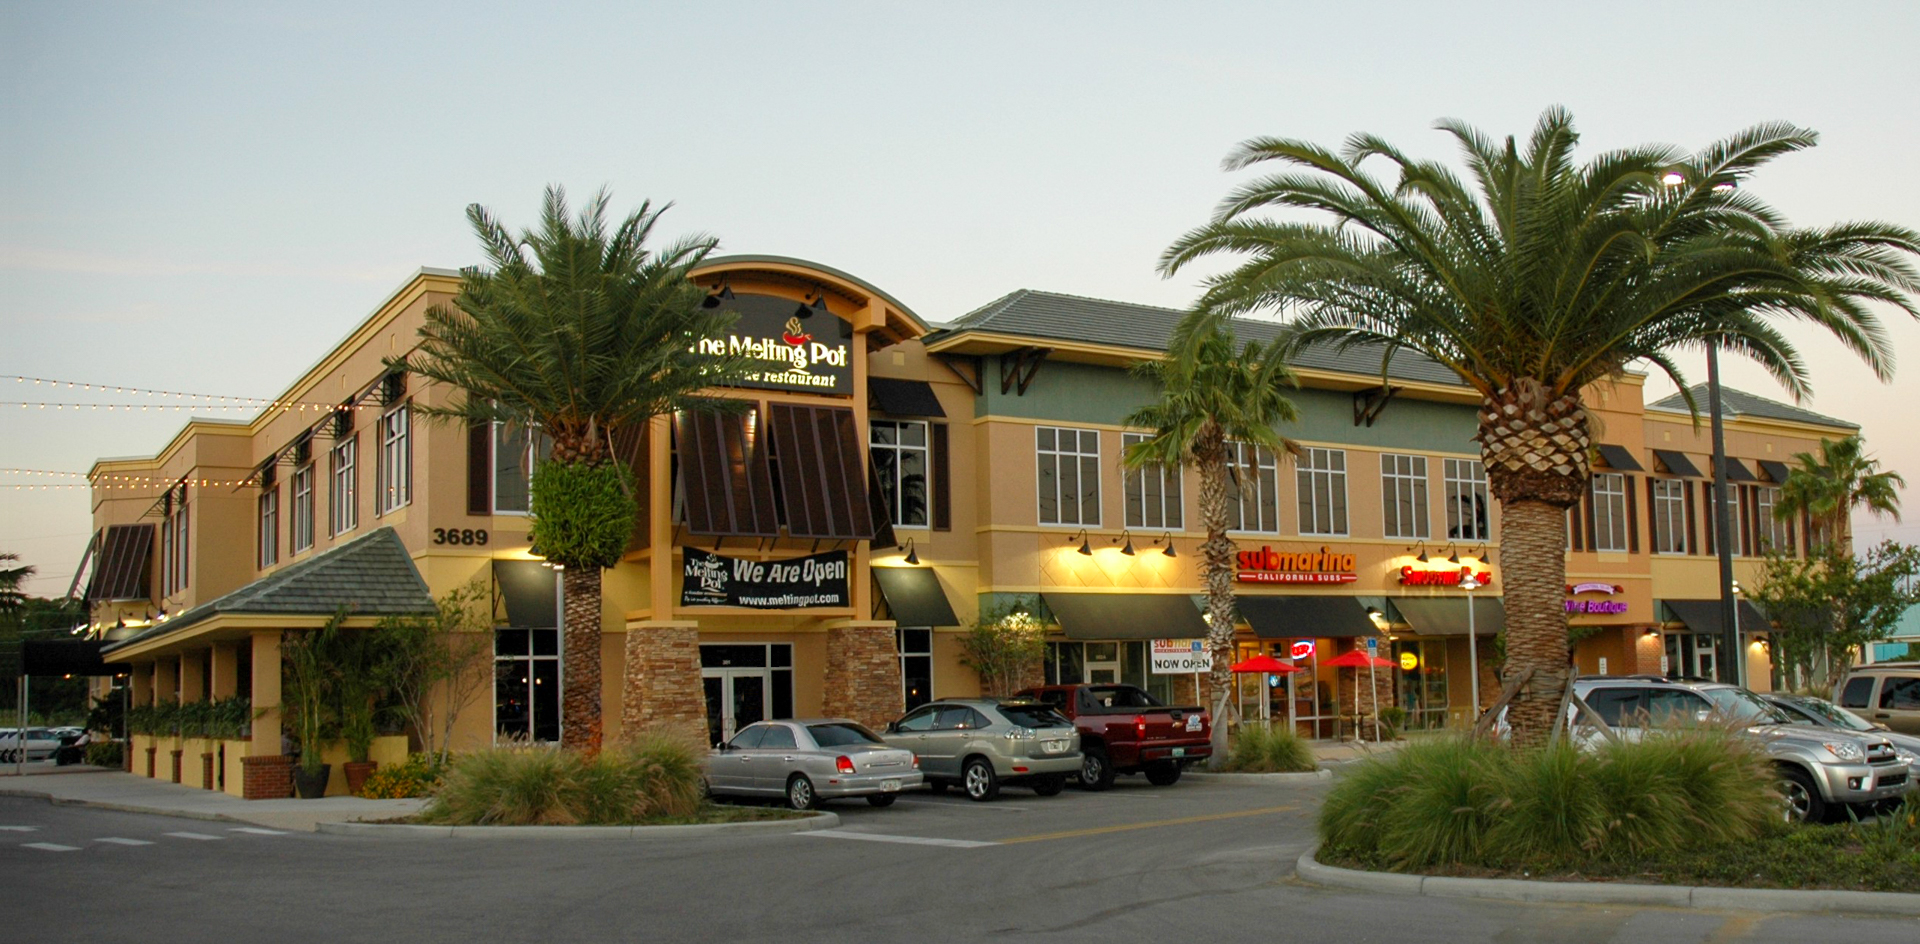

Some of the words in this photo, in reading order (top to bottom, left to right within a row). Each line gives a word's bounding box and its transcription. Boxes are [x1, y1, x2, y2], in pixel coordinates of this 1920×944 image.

[684, 331, 726, 355] he
[729, 335, 807, 368] Melting
[810, 343, 847, 366] Pot
[763, 371, 836, 387] restaurant
[433, 528, 488, 546] 3689
[690, 557, 705, 566] The
[1236, 545, 1357, 571] submarina
[685, 564, 728, 582] Melting
[733, 558, 765, 583] We
[766, 563, 800, 583] Are
[802, 558, 845, 587] Open
[701, 577, 722, 589] Pot
[739, 594, 840, 607] www.meltingpot.com
[1587, 599, 1628, 615] Boutique
[1155, 659, 1180, 669] NOW
